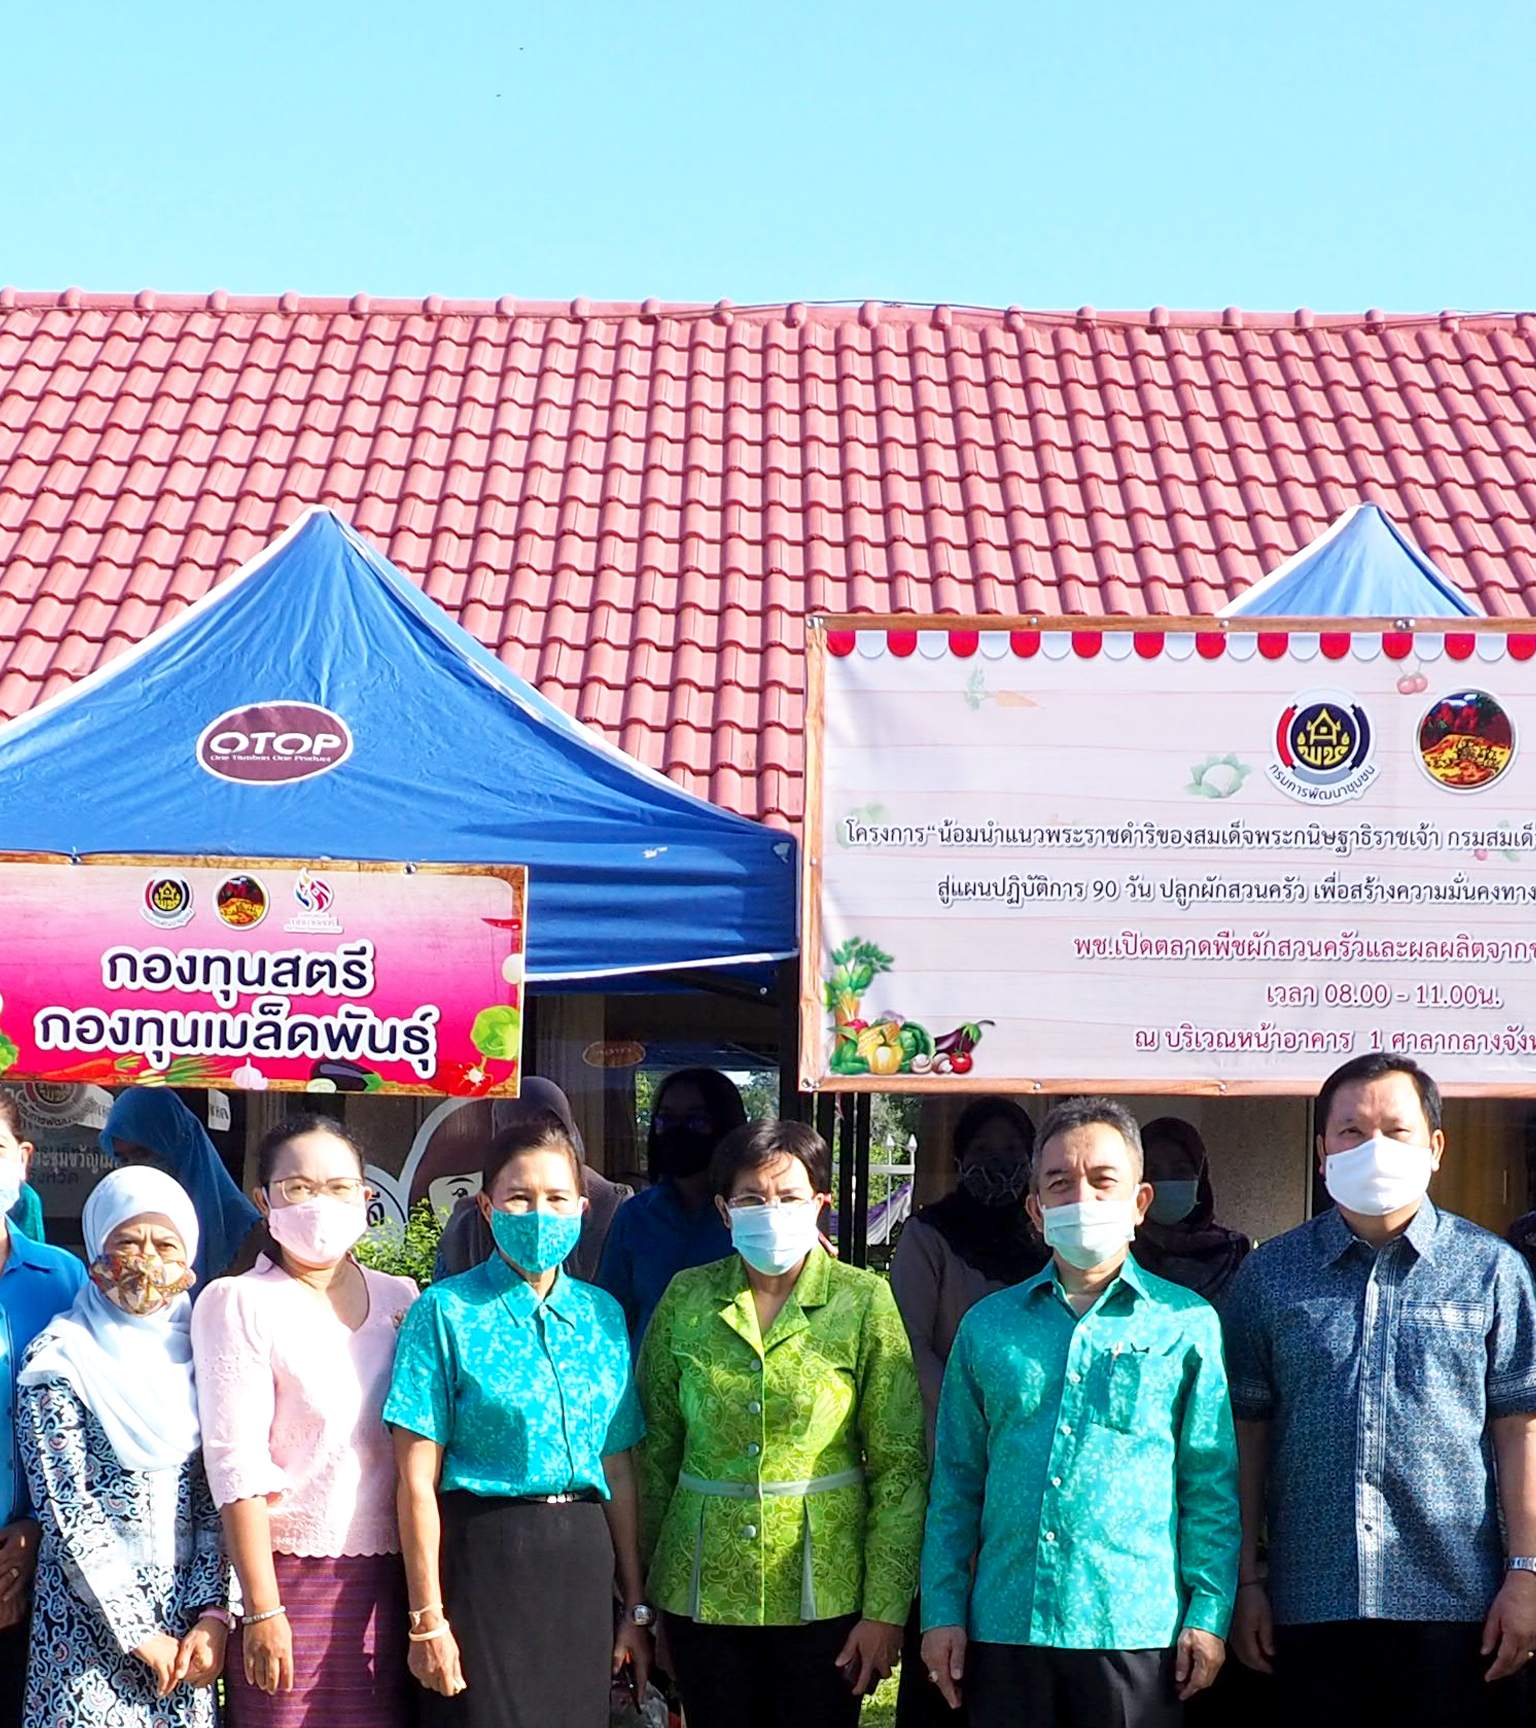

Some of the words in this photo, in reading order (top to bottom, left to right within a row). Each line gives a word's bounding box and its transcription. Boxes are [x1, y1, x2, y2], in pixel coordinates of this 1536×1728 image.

[209, 731, 342, 755] OTOP
[1268, 763, 1376, 801] กรมการพัฒนาชุมชน
[937, 874, 1084, 904] สู่แผนปฏิบัติการ
[1093, 880, 1117, 899] 90
[1125, 875, 1151, 899] วัน
[1160, 875, 1305, 906] ปลูกผักสวนครัว
[107, 944, 369, 1001] กองทุนสตรี
[1266, 984, 1314, 1004] เวลา
[1324, 983, 1388, 1004] 08.00
[1416, 984, 1500, 1005] 11.00น.
[40, 1001, 436, 1070] กองทุนเมล็ดพันธุ์
[1135, 1030, 1155, 1050] ณ
[1165, 1023, 1350, 1051] บริเวณหน้าอาคาร
[1369, 1030, 1381, 1050] 1
